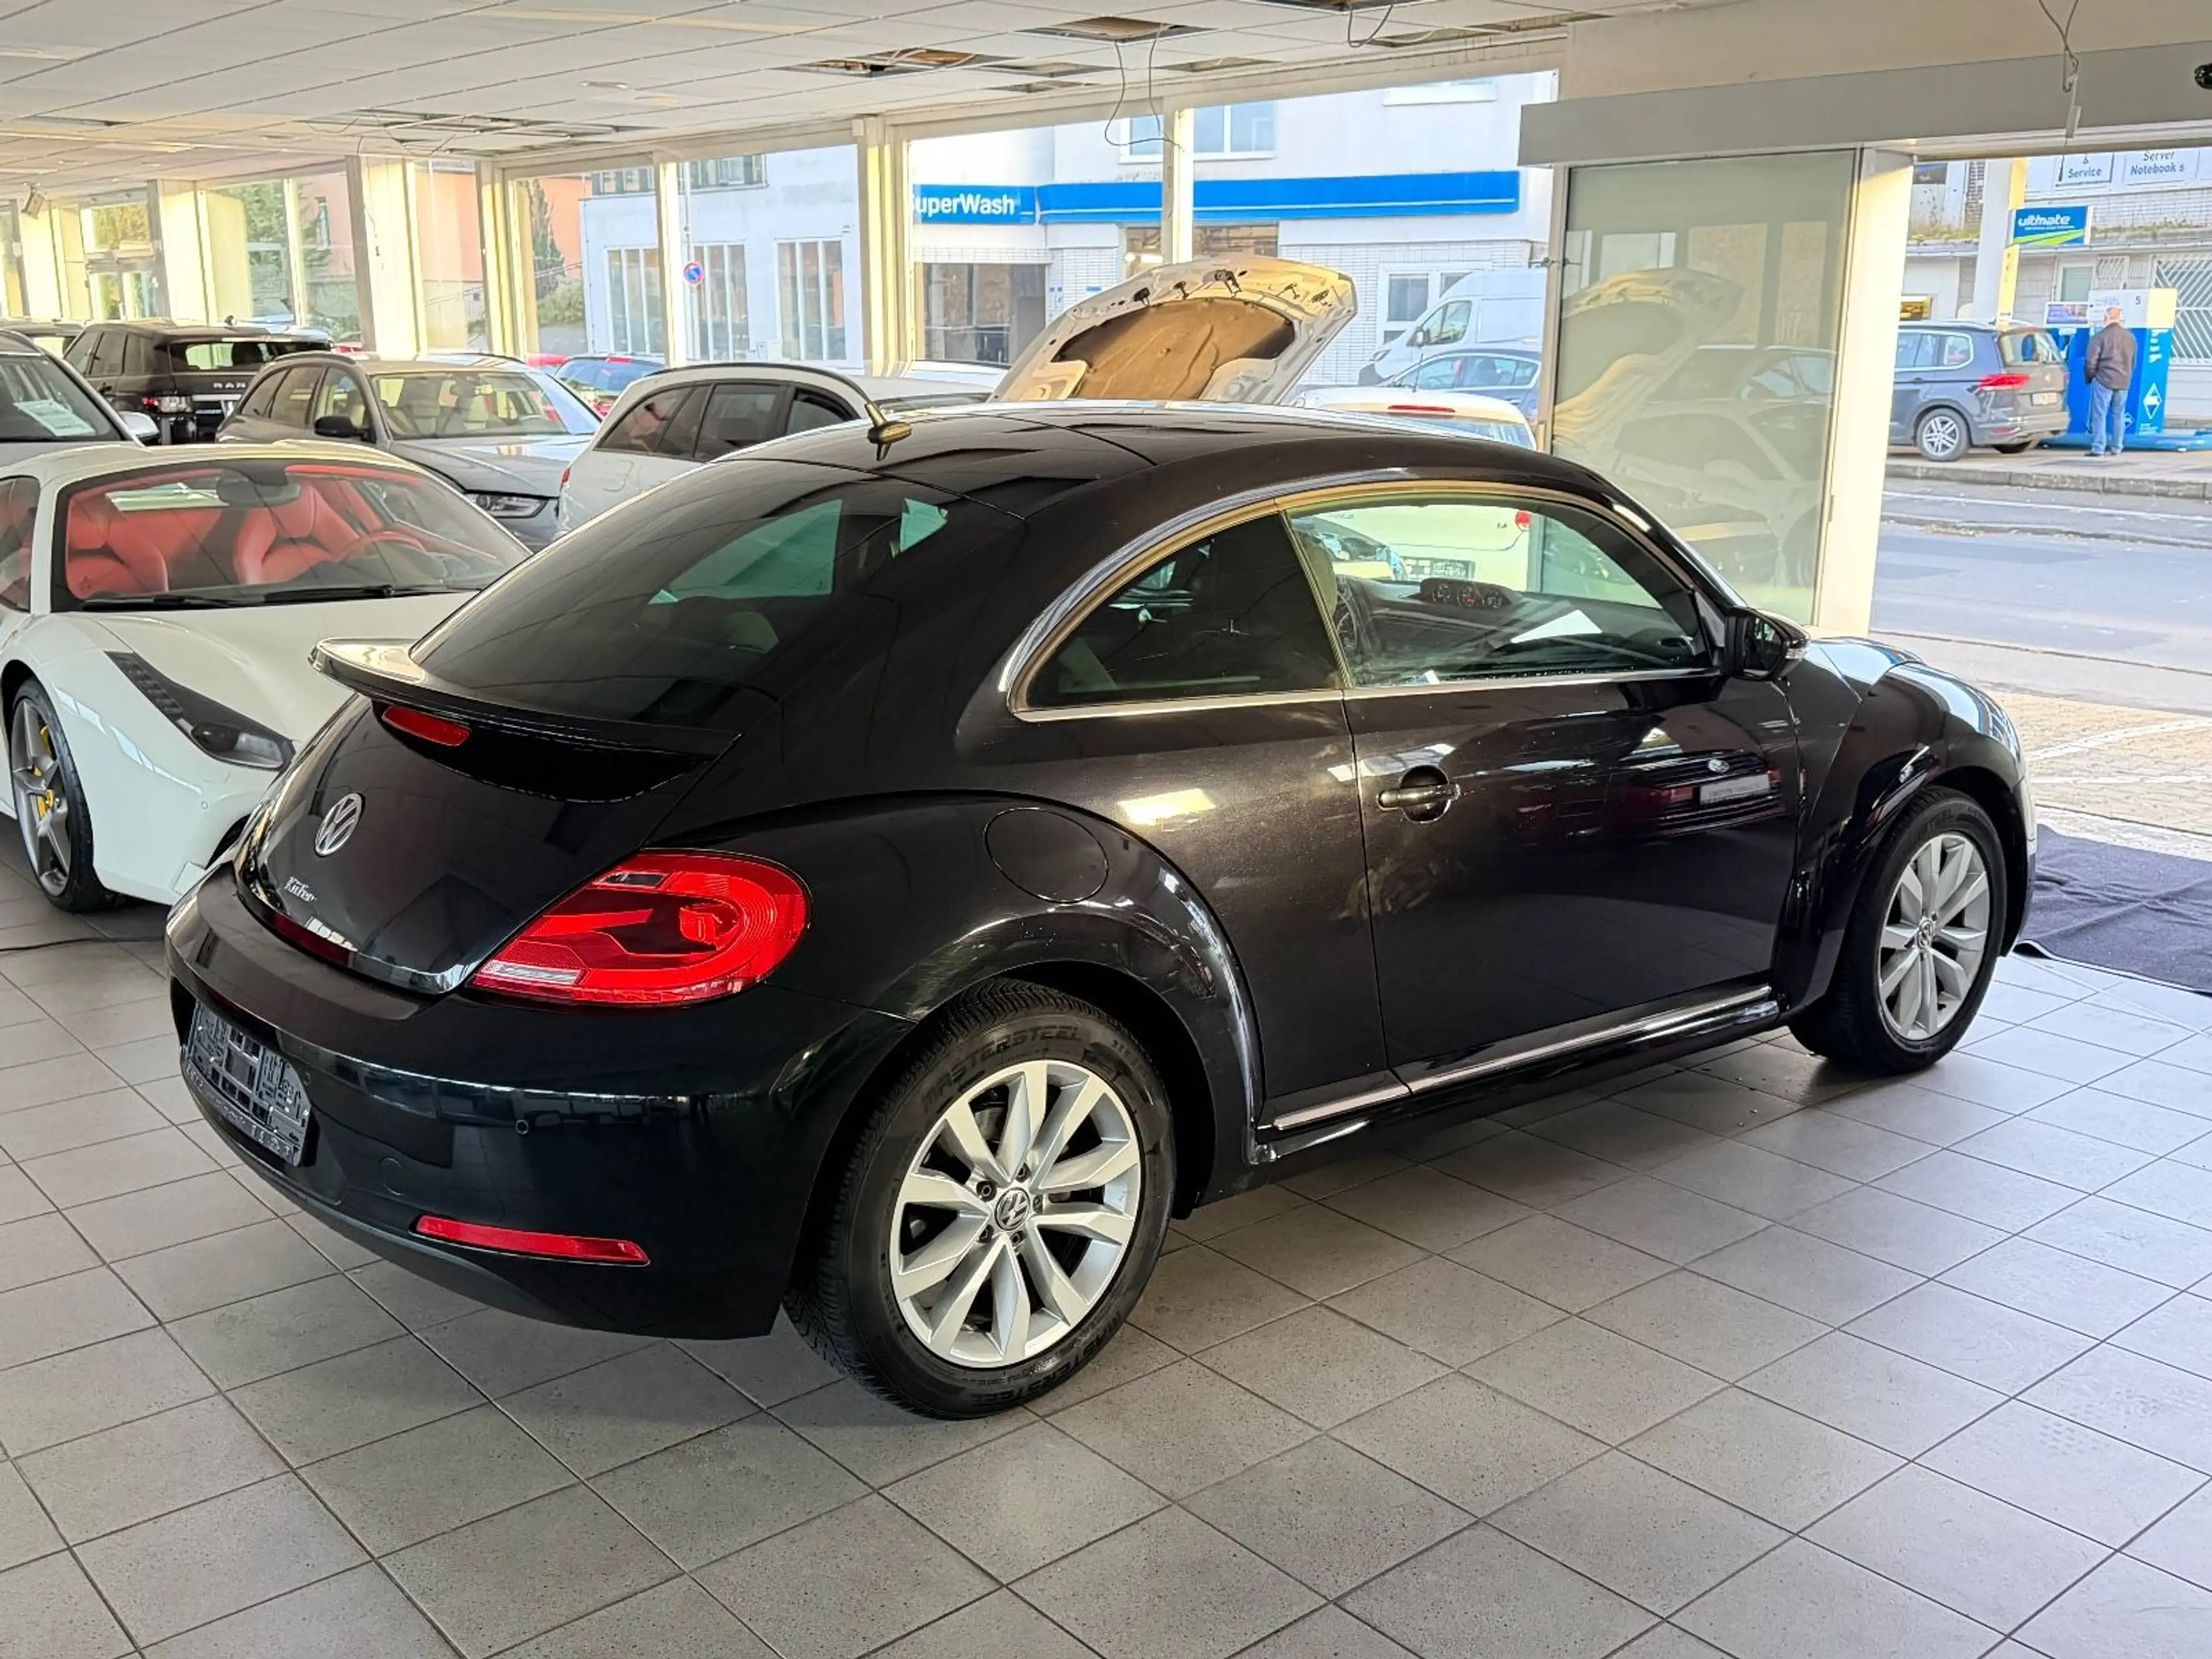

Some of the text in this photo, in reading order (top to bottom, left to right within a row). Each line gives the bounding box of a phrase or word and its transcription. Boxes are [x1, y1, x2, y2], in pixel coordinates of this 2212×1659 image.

[2068, 166, 2103, 179] Service
[911, 193, 1016, 218] uperWash
[2017, 214, 2071, 226] ultimate
[2135, 295, 2141, 305] 5
[923, 1025, 1082, 1107] MASTERSTEEL
